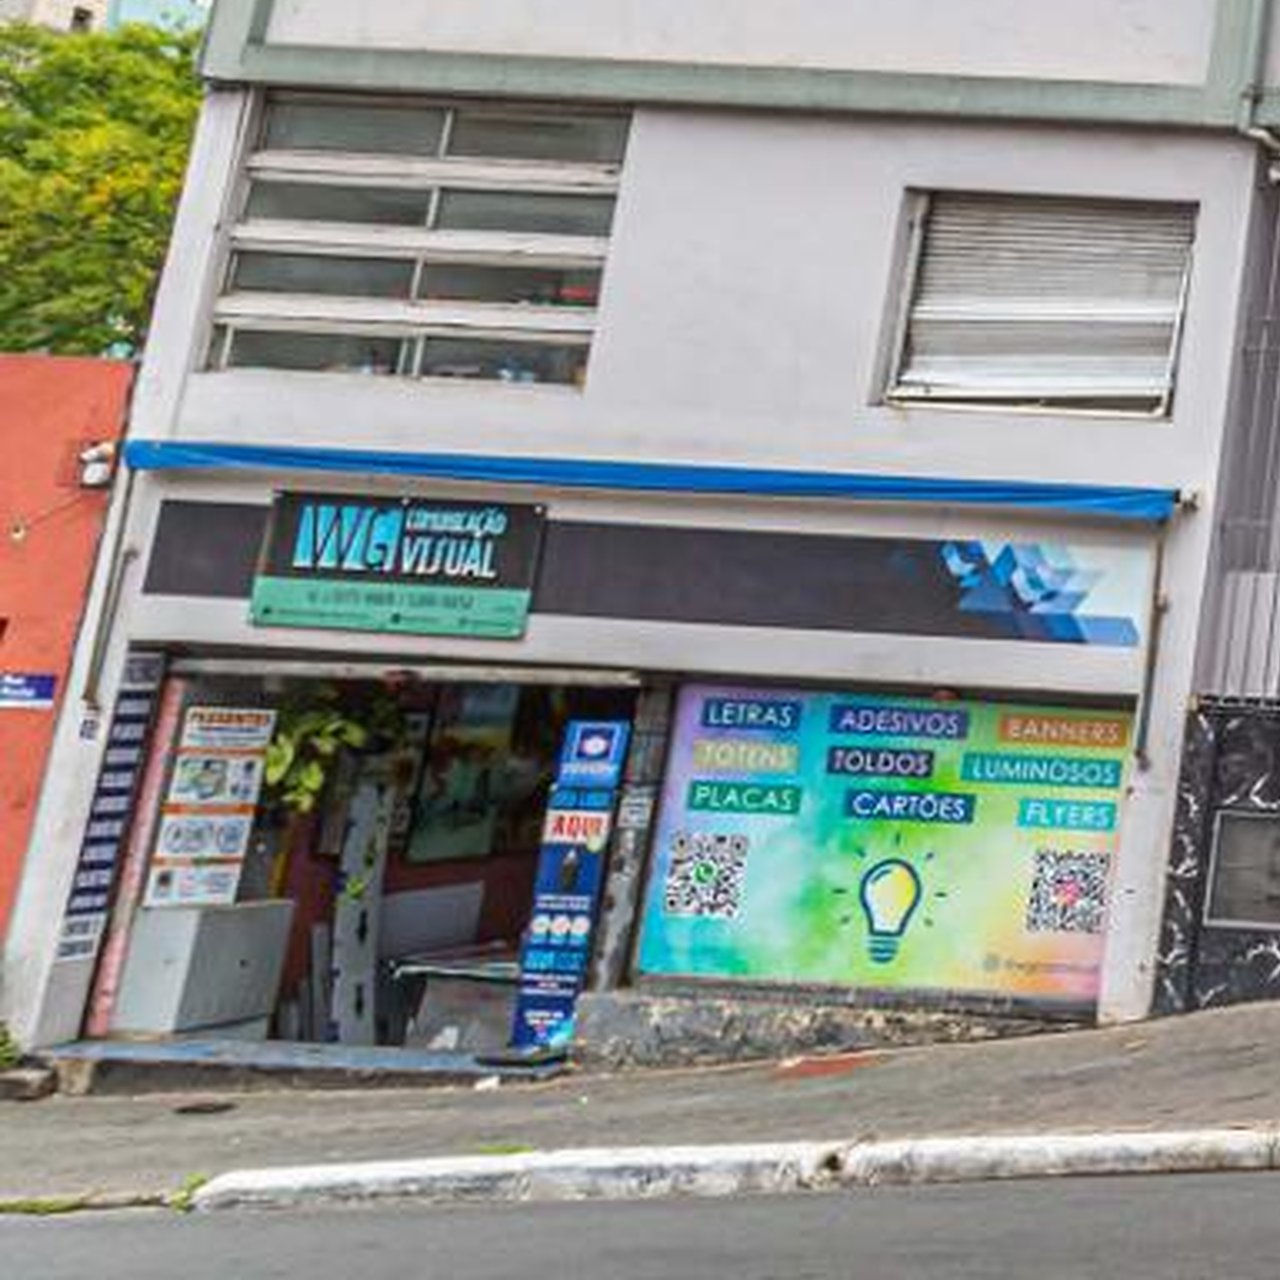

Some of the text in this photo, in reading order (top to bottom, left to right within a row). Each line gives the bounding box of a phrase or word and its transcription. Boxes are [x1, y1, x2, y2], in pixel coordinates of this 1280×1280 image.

[402, 535, 498, 578] VISUAL
[708, 701, 794, 727] LETRAS
[839, 708, 960, 735] ADESIVOS
[1009, 717, 1122, 741] BANNERS
[834, 749, 930, 776] TOLDOS
[973, 755, 1117, 785] LUMINOSOS
[693, 785, 794, 811] PLACAS
[852, 791, 966, 820] CARTÕES
[1025, 801, 1111, 828] FLYERS
